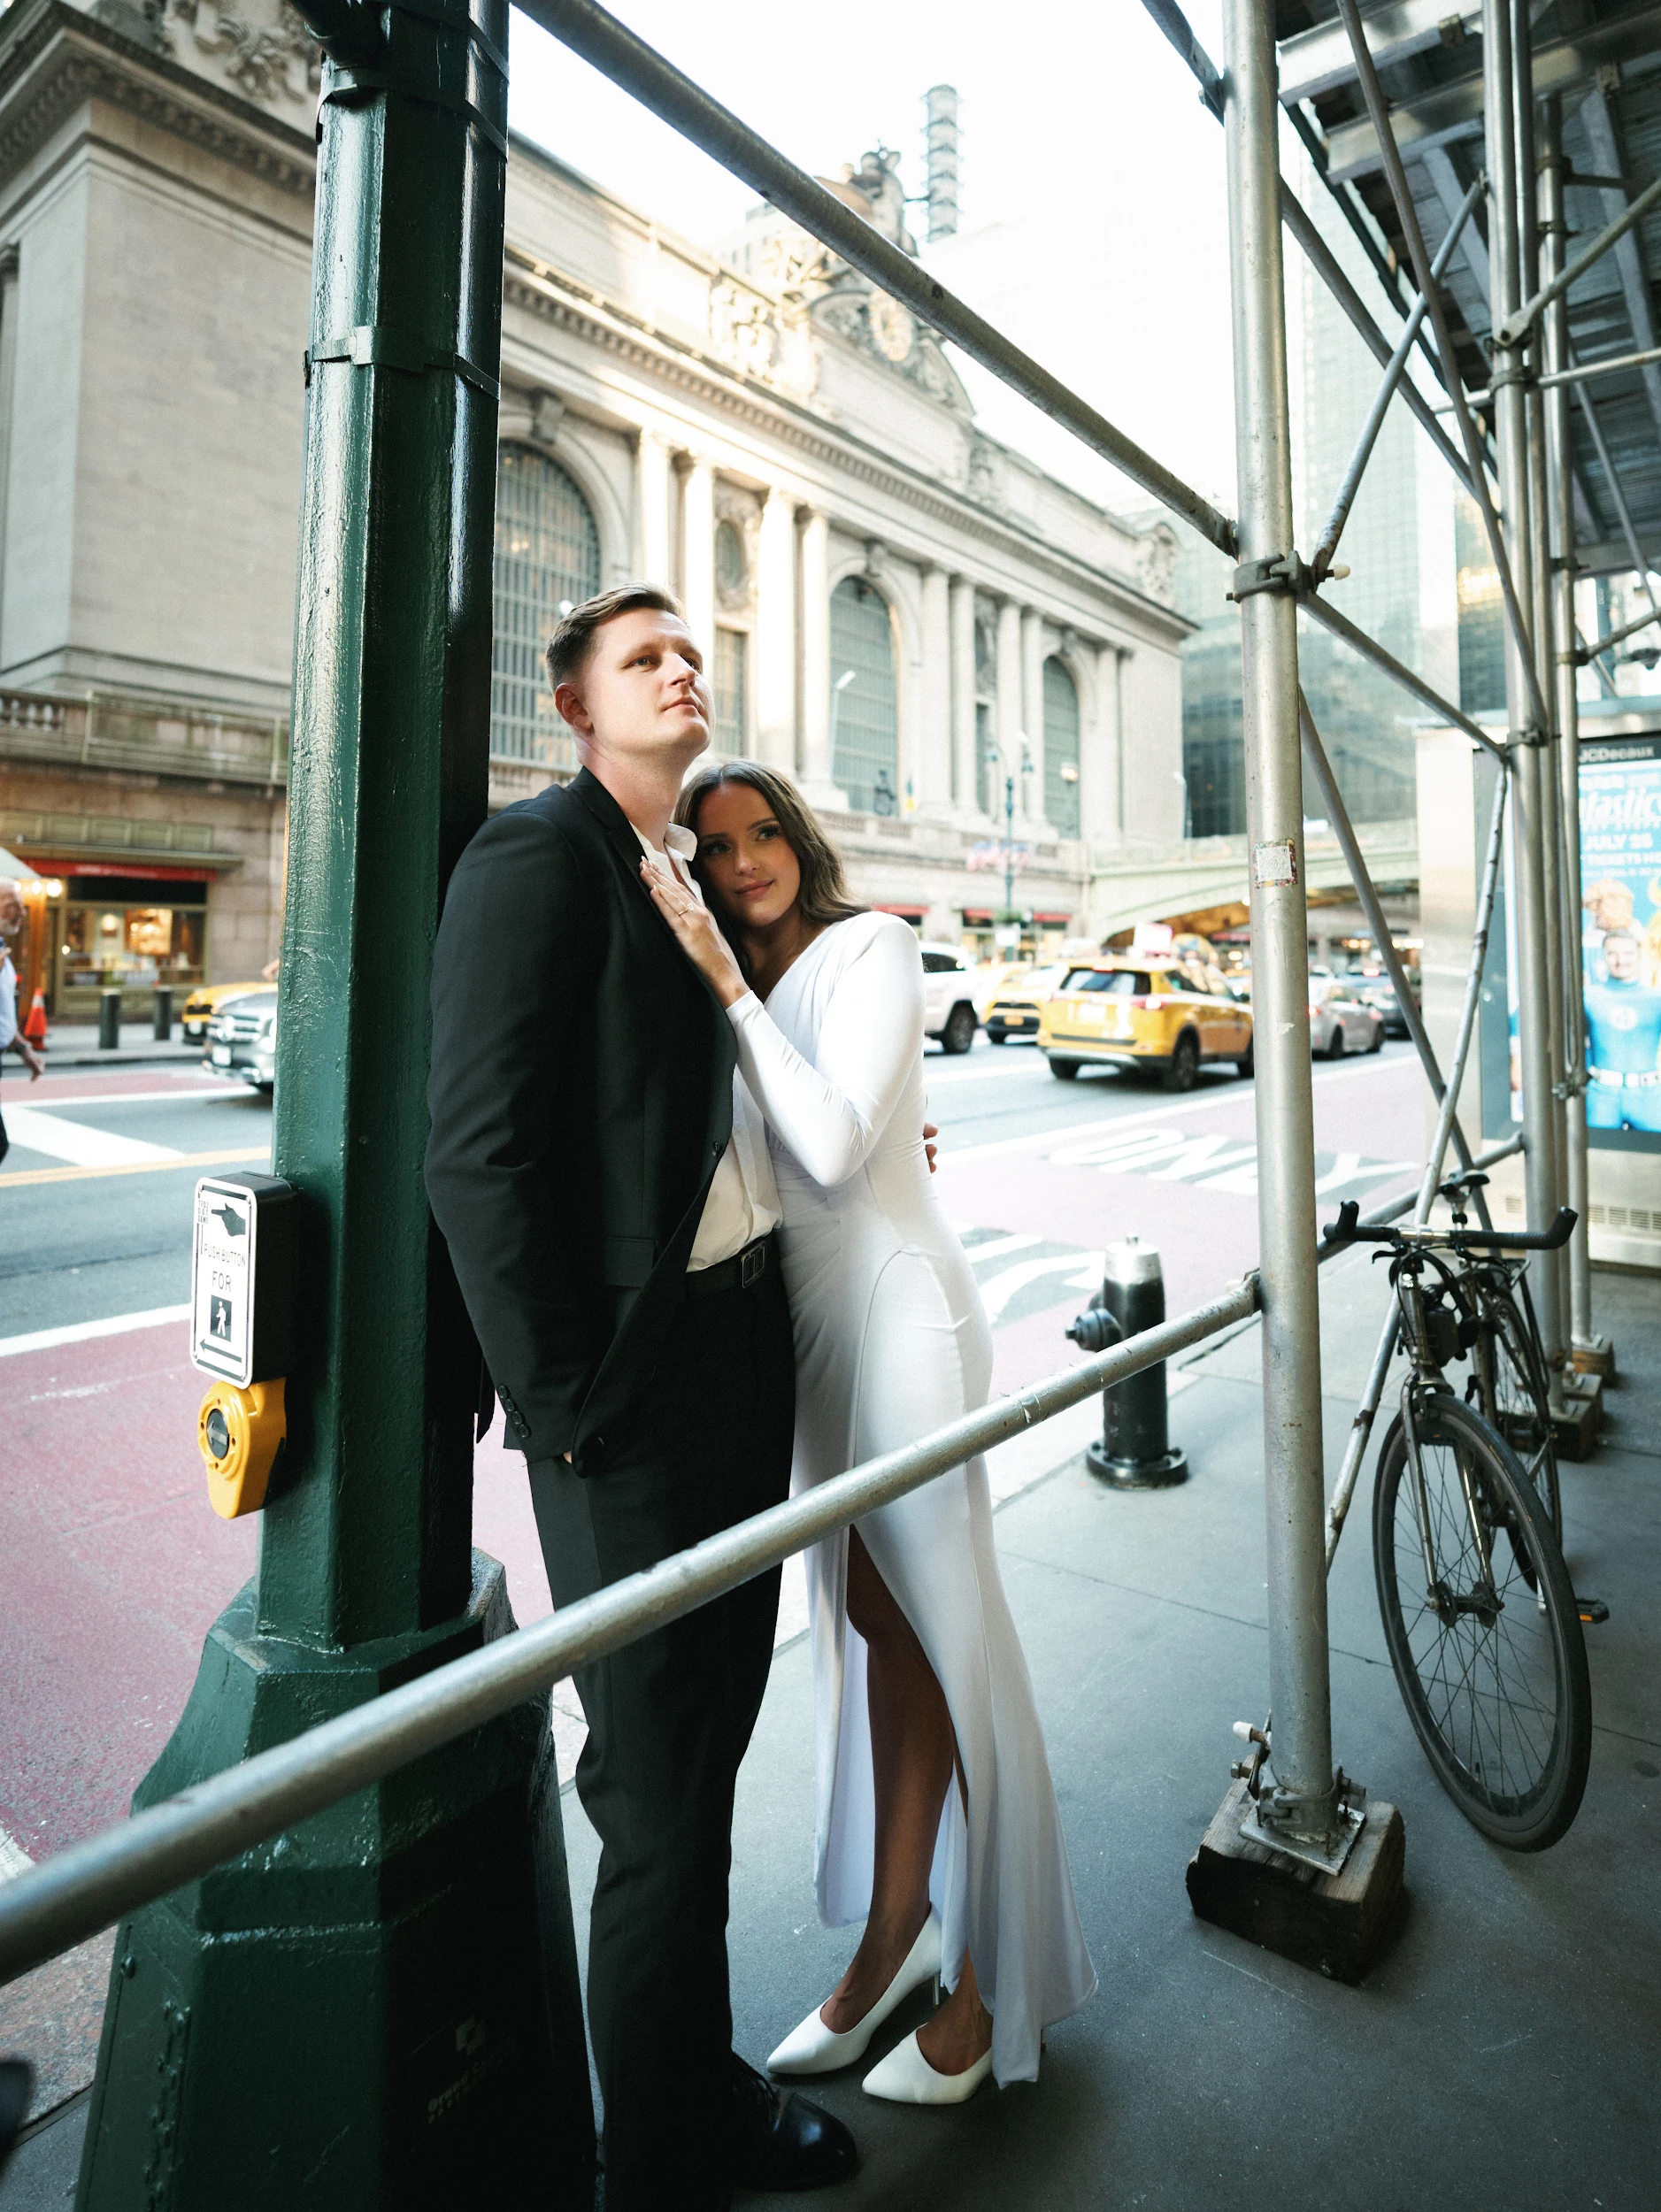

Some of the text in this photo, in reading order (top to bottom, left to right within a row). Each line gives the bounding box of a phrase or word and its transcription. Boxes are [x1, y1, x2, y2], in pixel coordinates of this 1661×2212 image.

[1579, 746, 1654, 763] JCDecaux
[1583, 834, 1626, 851] JULY
[204, 1243, 246, 1268] PUSH BUTTON
[211, 1270, 232, 1293] FOR
